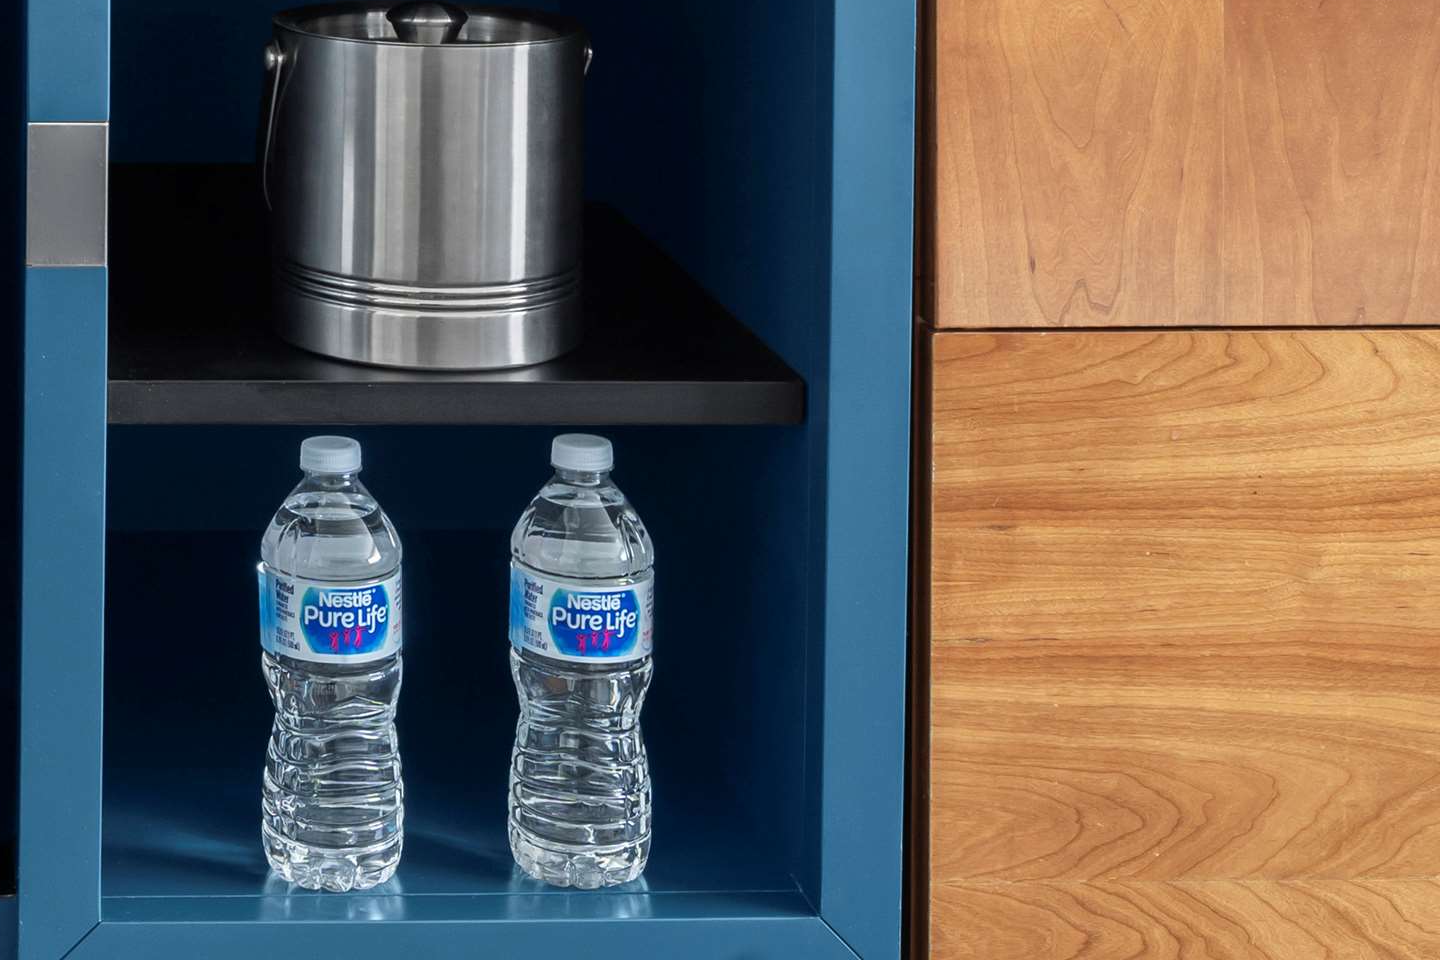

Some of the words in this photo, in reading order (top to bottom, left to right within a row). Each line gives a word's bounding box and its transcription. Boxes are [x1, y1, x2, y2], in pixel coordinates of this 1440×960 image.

[304, 606, 355, 628] Pure
[358, 604, 387, 634] Life
[552, 607, 603, 631] Pure
[606, 609, 636, 638] Life
